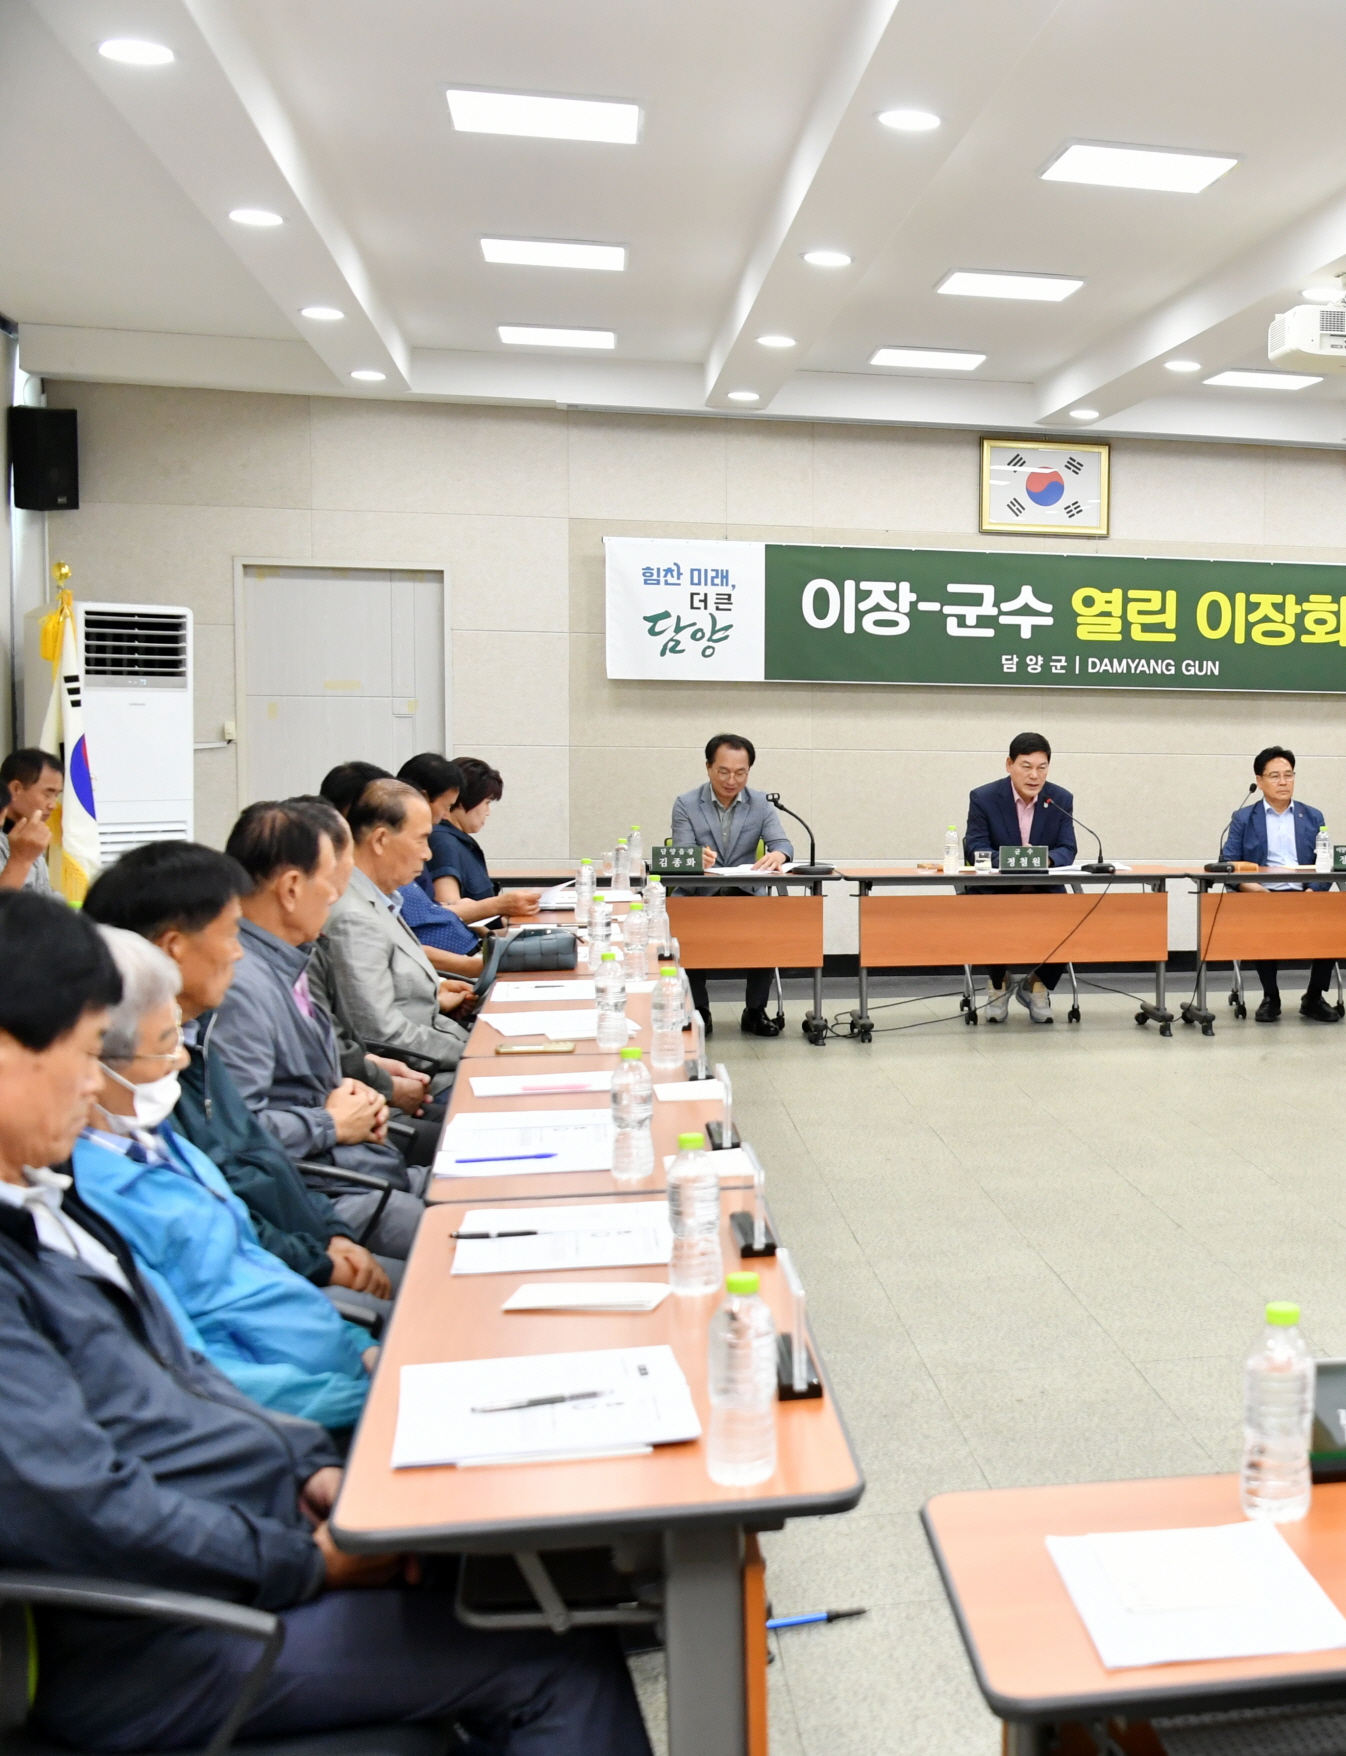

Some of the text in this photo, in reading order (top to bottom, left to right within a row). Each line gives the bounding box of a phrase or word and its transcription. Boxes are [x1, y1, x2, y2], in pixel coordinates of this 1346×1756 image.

[642, 562, 736, 591] 힘찬 미래,
[690, 592, 733, 611] 더 큰
[801, 578, 1054, 639] 이장-군수
[1071, 587, 1177, 642] 열린
[642, 610, 734, 658] 담양
[1088, 657, 1220, 676] DAMYANG GUN
